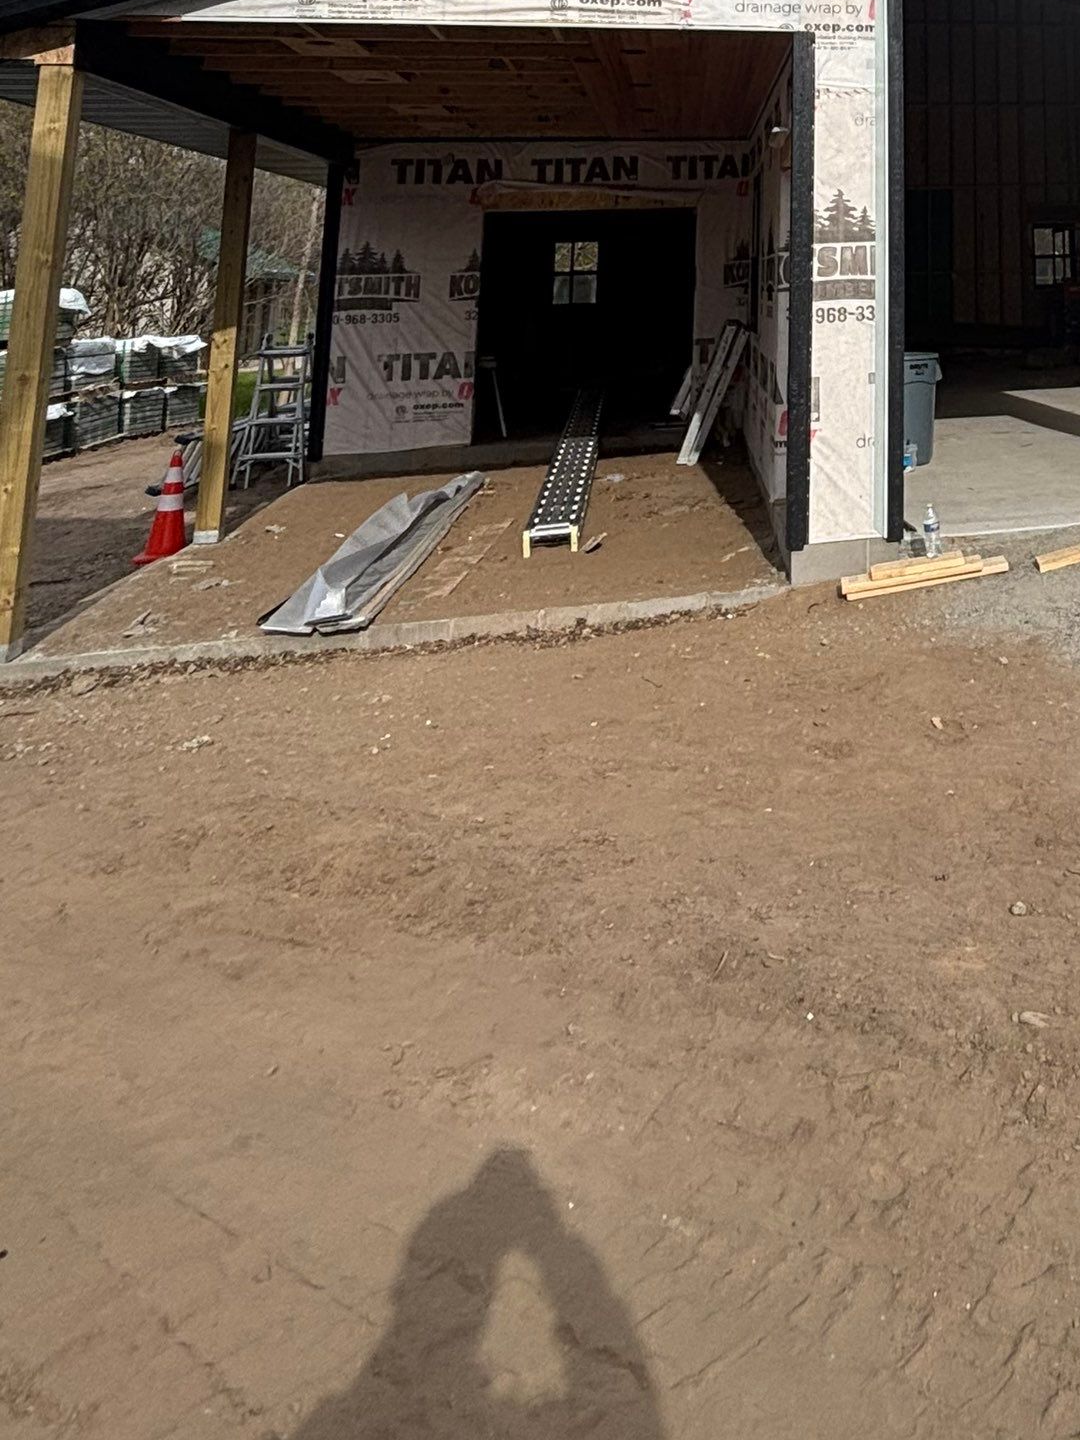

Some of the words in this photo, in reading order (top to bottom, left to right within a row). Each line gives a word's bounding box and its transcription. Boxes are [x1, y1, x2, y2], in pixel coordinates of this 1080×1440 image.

[735, 0, 801, 17] drainage
[805, 4, 841, 16] wrap
[845, 1, 862, 17] by
[391, 158, 503, 185] TITAN
[531, 155, 638, 185] TITAN
[413, 403, 464, 411] oxep.com
